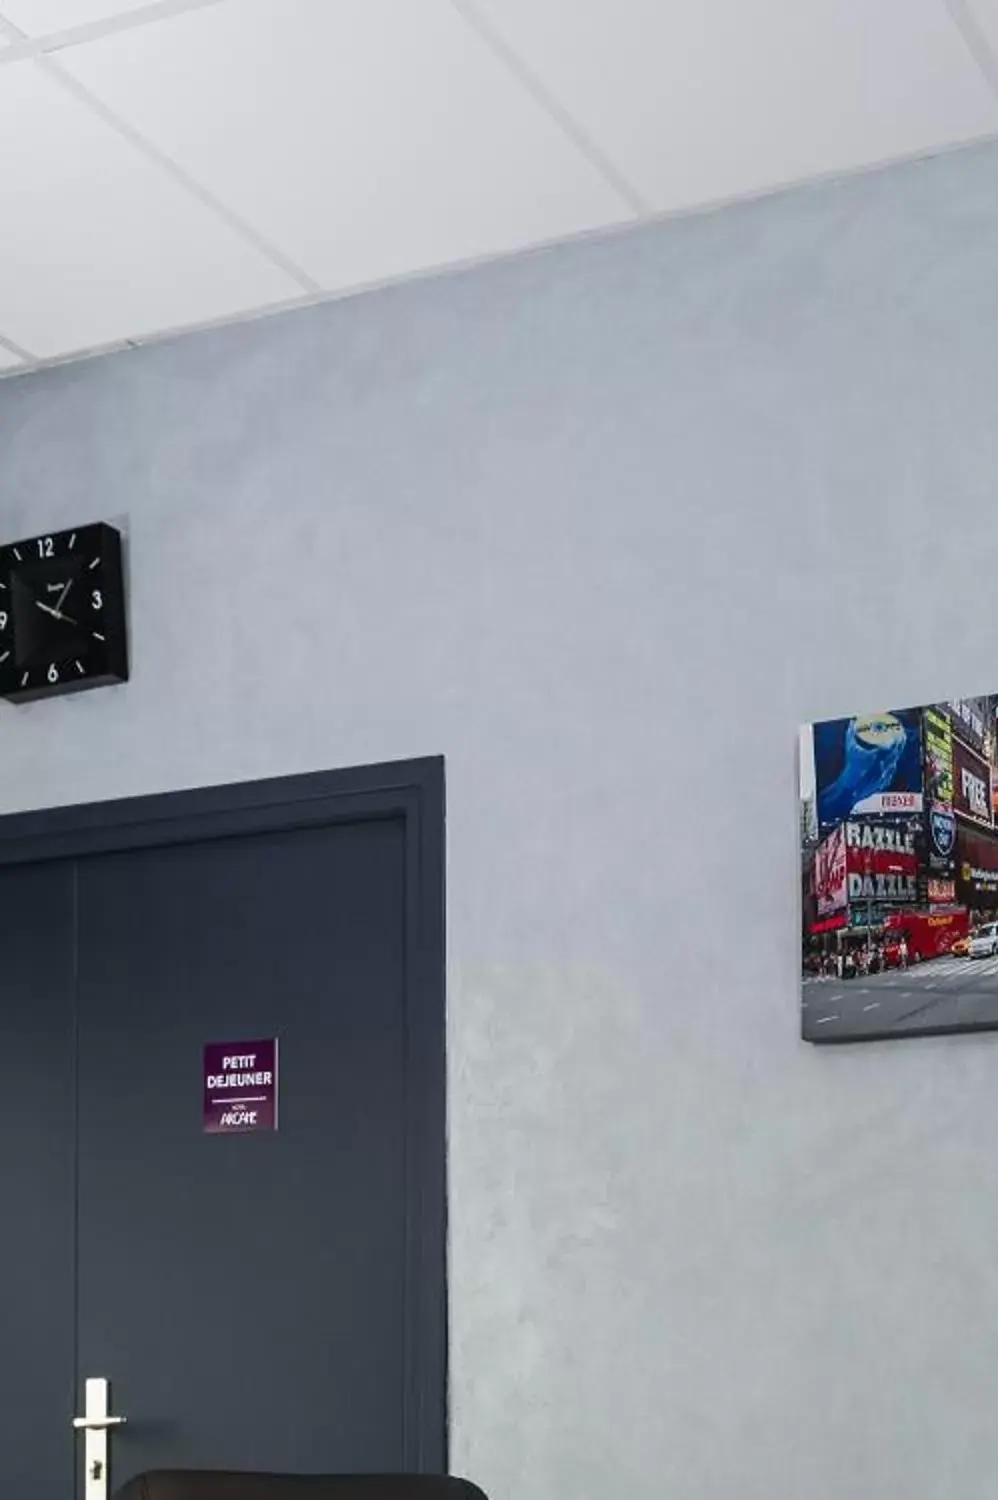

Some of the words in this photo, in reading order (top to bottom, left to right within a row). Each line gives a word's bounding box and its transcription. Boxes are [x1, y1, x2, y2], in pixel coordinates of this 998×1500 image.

[38, 538, 55, 557] 12
[91, 590, 102, 609] 3
[47, 662, 59, 682] 6
[846, 821, 915, 855] RAZZLE
[848, 871, 917, 899] DAZZLE
[223, 1054, 256, 1069] PETIT
[207, 1072, 272, 1088] DEJEUNER
